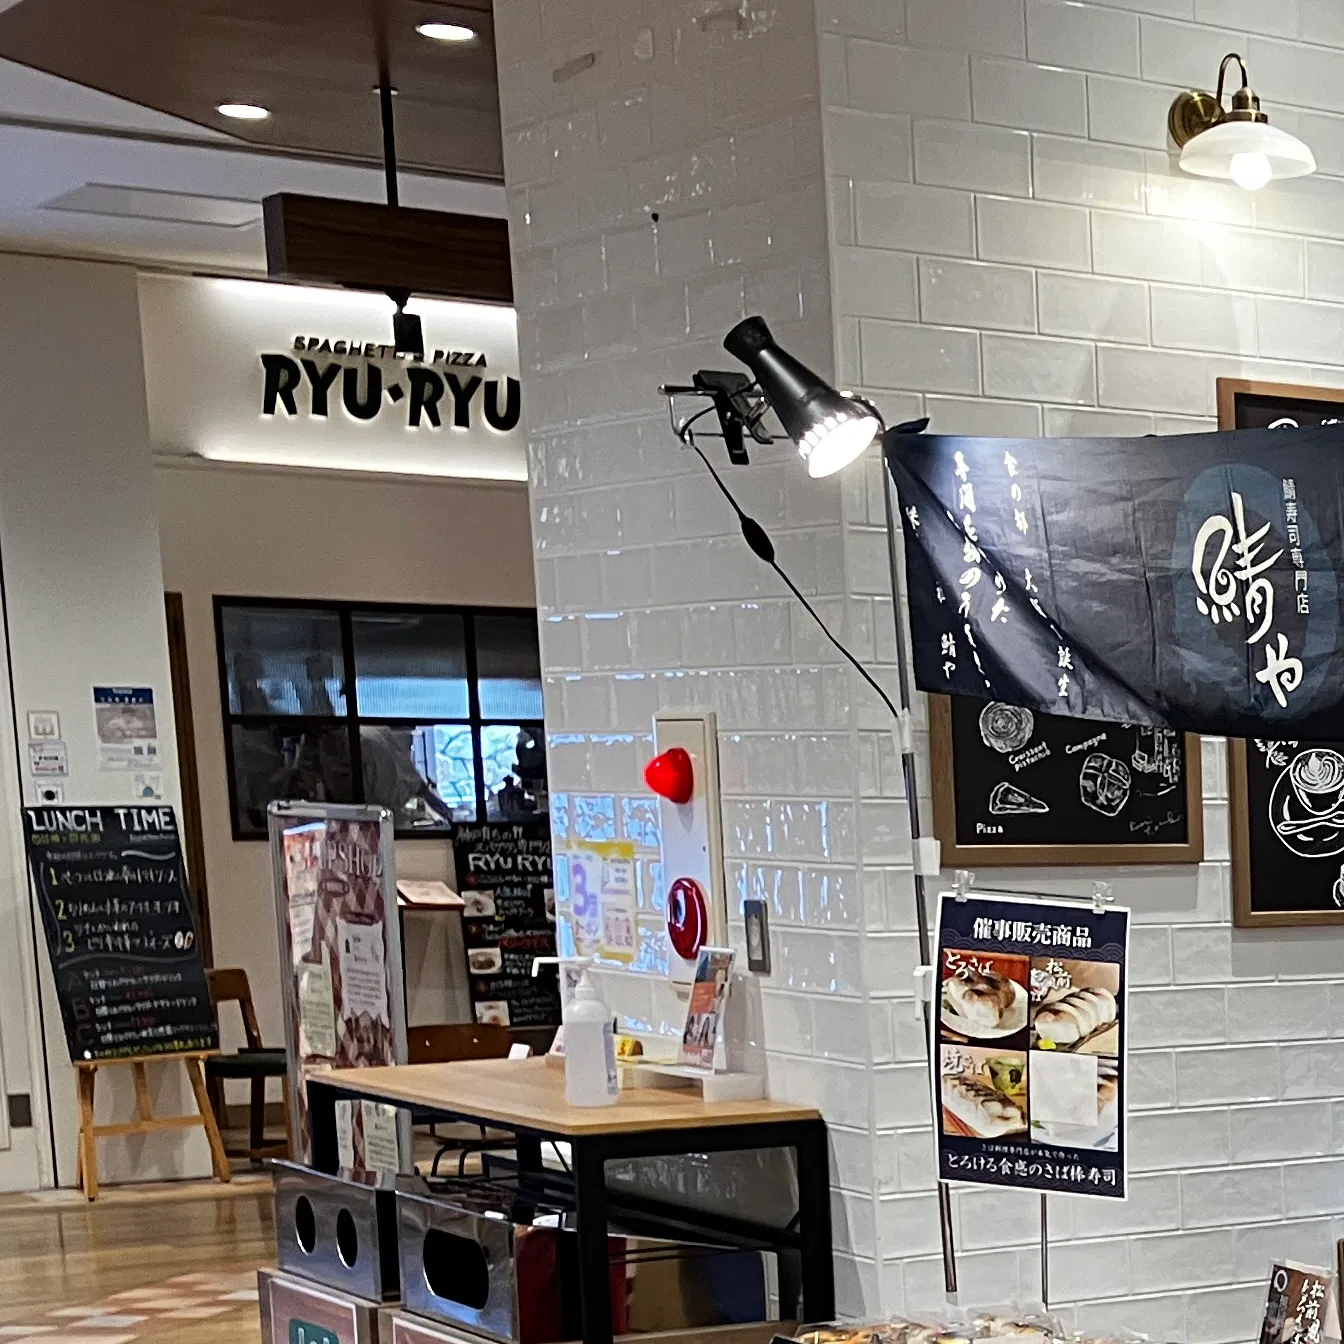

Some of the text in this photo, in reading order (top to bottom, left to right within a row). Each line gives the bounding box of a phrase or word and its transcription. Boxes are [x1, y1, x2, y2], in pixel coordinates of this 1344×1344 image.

[433, 350, 487, 367] PIZZA
[1282, 478, 1310, 615] 鯖寿司専門店
[1191, 492, 1304, 708] 鯖や
[27, 807, 177, 832] LUNCH TIME
[976, 822, 1004, 834] Pizza
[973, 917, 1092, 949] 催事販売商品
[947, 1153, 1117, 1186] とろける食感のさば棒寿司
